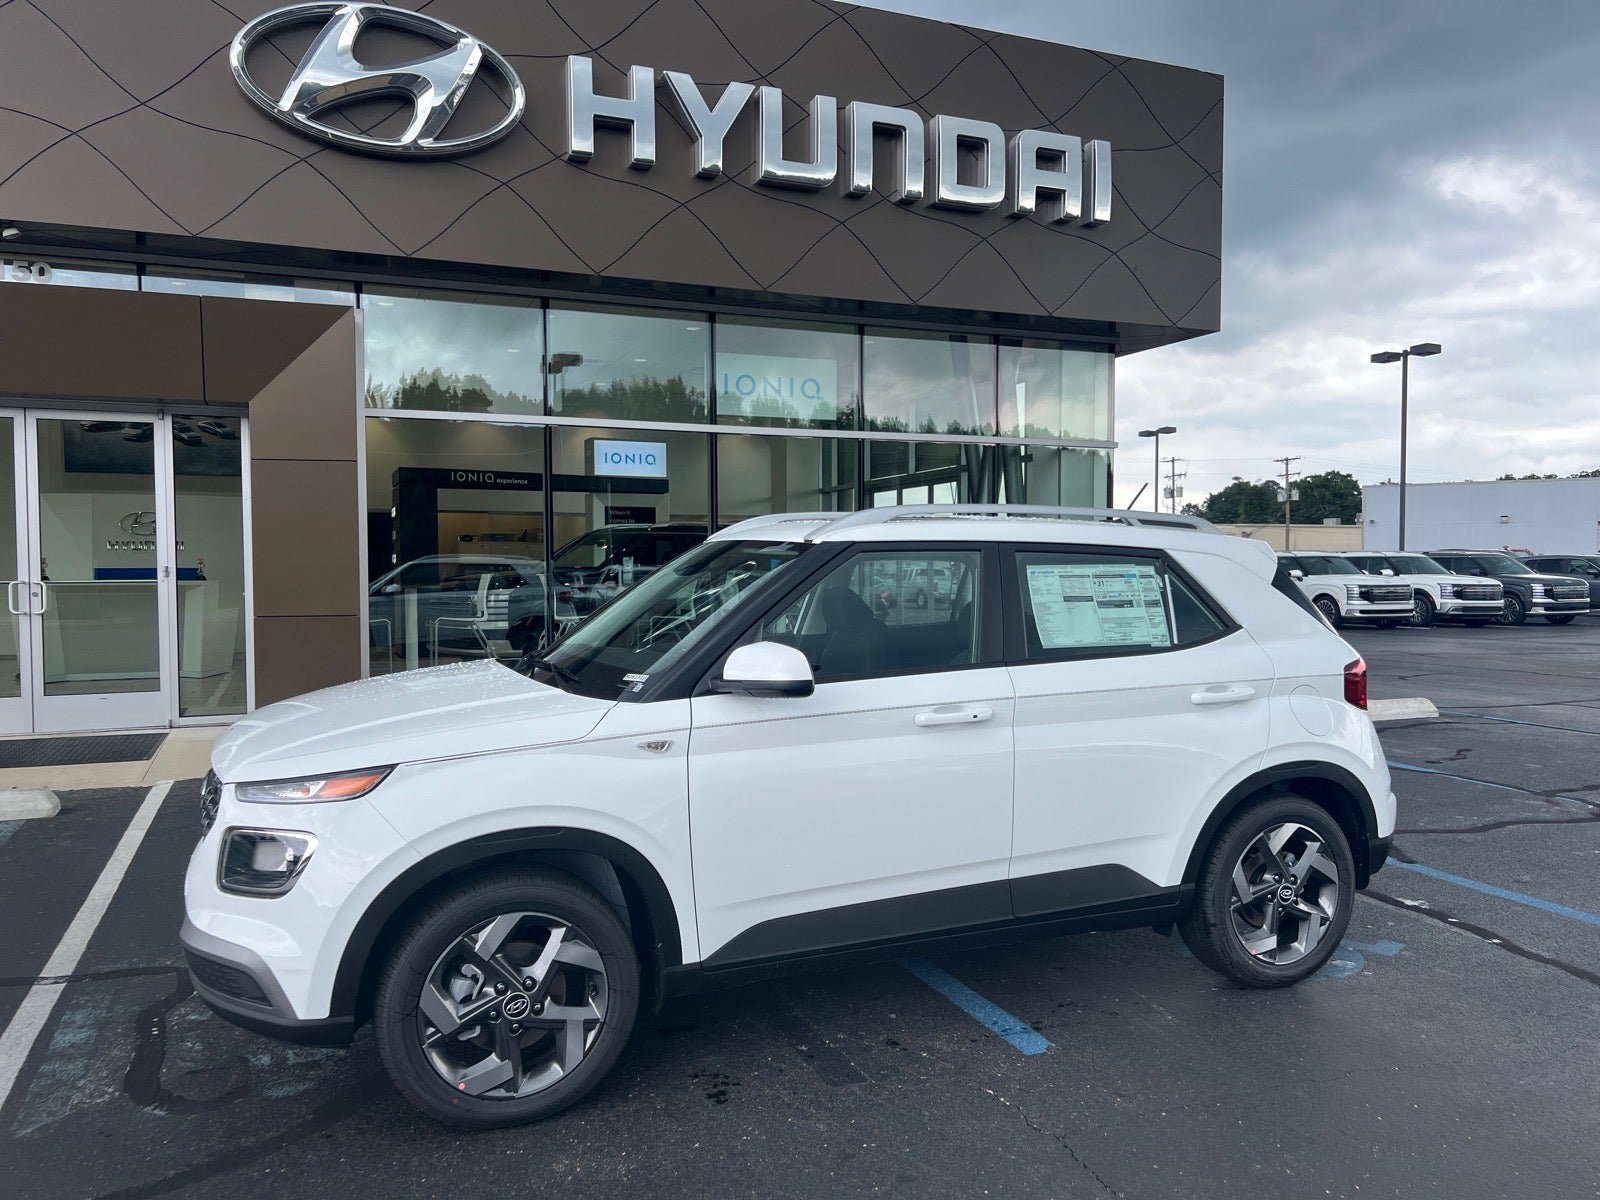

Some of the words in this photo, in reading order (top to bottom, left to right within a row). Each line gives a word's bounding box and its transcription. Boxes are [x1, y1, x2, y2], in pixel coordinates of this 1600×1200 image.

[565, 54, 1112, 225] HYUNDAI
[724, 373, 821, 399] IONIQ
[604, 452, 656, 466] IONIQ
[451, 471, 495, 483] IONIQ
[106, 540, 185, 551] HYUNI
